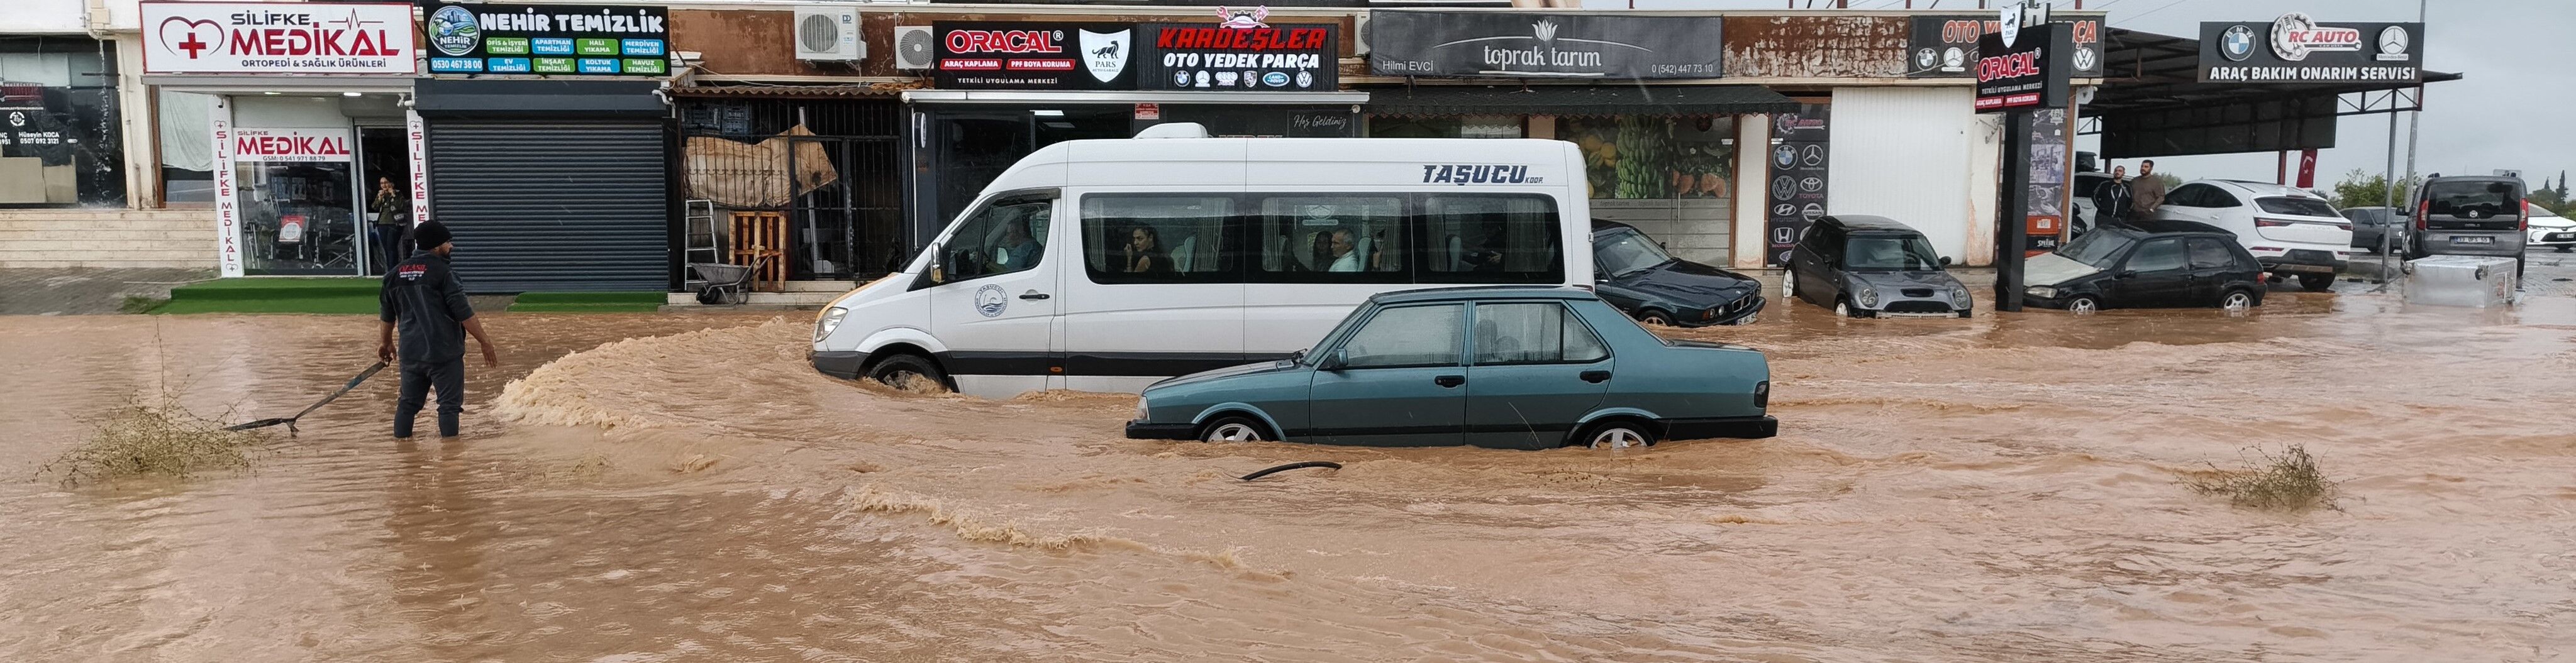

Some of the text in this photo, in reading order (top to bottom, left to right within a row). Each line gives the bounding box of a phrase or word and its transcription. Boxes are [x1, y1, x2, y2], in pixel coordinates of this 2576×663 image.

[231, 9, 310, 25] SİLİFKE
[480, 7, 663, 33] NEHİR TEMİZLİK
[230, 21, 400, 56] MEDİKAL
[1157, 27, 1328, 50] KARDEŞLER
[1942, 20, 1980, 43] OTO
[2288, 31, 2358, 43] RC AUTO
[440, 36, 470, 45] NEHİR
[242, 58, 291, 67] ORTOPEDİ
[302, 58, 336, 67] SAĞLIK
[338, 58, 386, 67] ÜRÜNLERİ
[433, 60, 482, 69] 0530 467 38 00
[944, 60, 963, 68] ARAÇ
[1163, 53, 1319, 71] OTO YEDEK PARÇA
[1484, 45, 1601, 70] toprak tarım
[1383, 60, 1433, 72] Hilmi EVCİ
[1652, 64, 1713, 75] 0 (542) 447 73 10
[2209, 67, 2416, 82] ARAÇ BAKIM ONARIM SERVİSİ
[1982, 80, 2042, 94] YETKİLİ UYGULAMA MERKEZİ
[1294, 114, 1347, 130] Hoş Geldiniz
[237, 131, 350, 155] MEDİKAL
[1423, 165, 1528, 185] TAŞUCU
